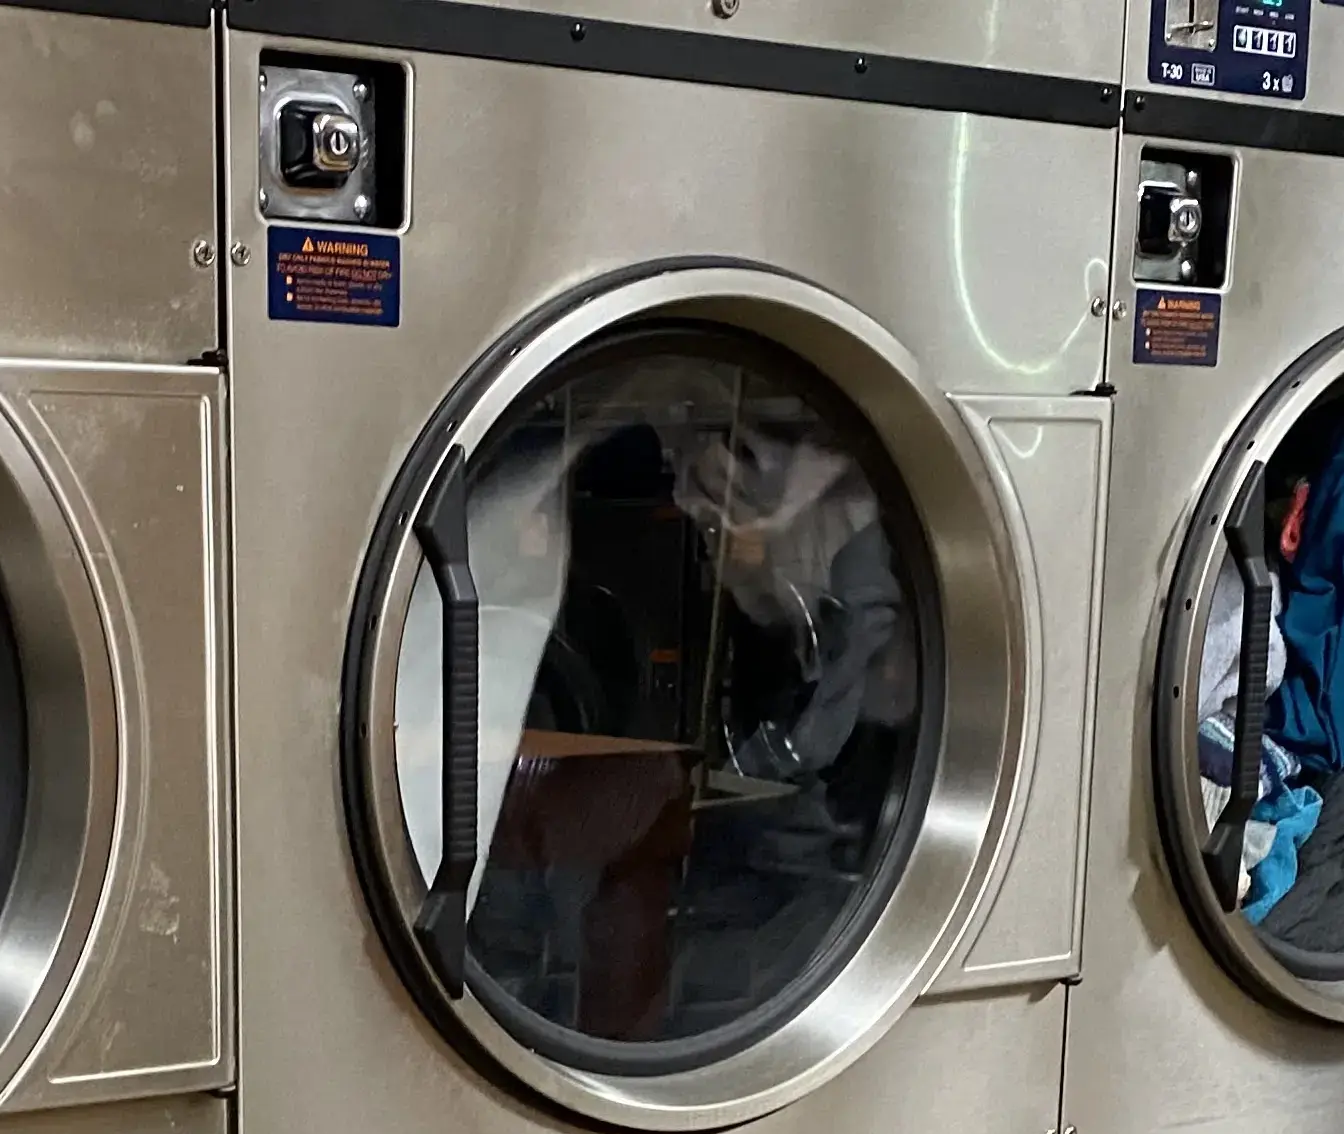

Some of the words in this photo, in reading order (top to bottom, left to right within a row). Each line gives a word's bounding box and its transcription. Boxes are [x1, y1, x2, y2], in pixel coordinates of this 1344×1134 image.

[1161, 62, 1183, 80] T-30
[1262, 71, 1271, 90] 3
[317, 240, 368, 256] WARNING
